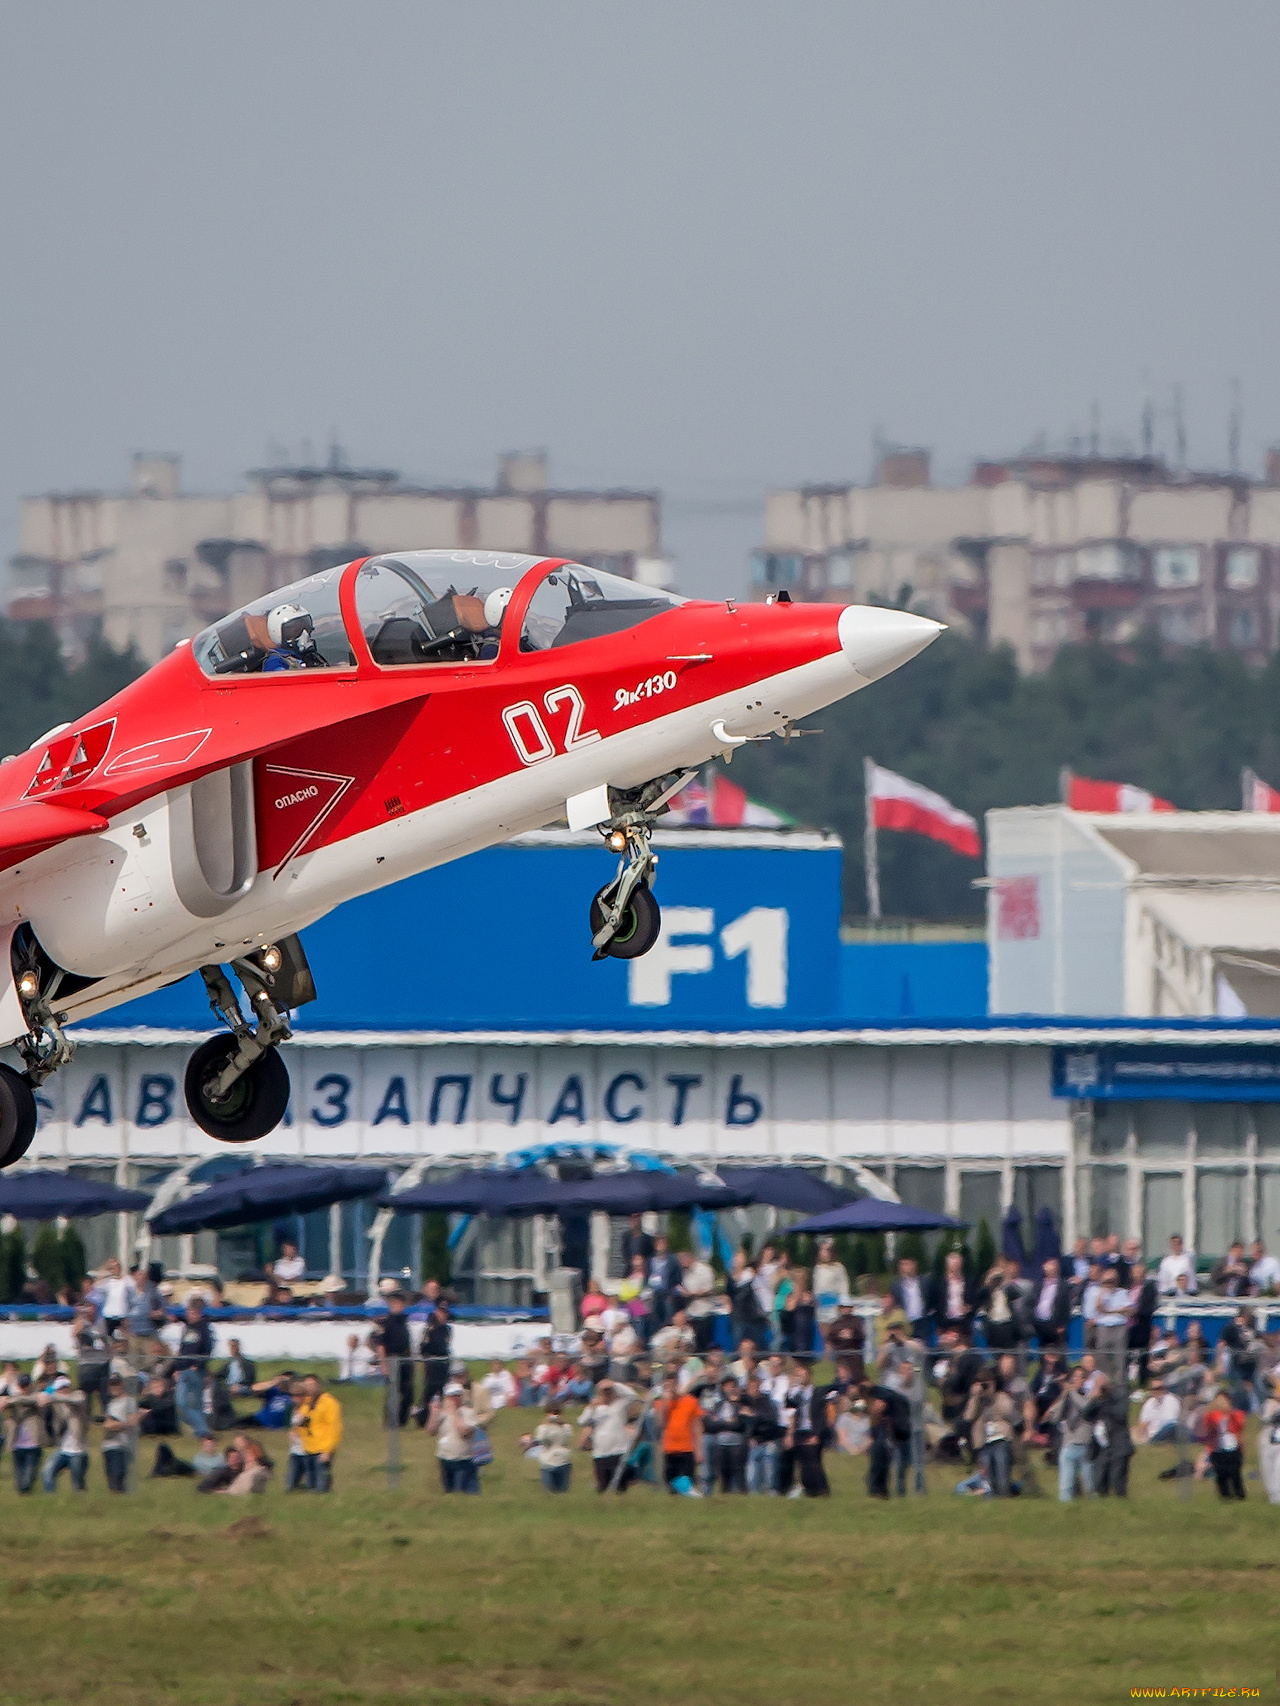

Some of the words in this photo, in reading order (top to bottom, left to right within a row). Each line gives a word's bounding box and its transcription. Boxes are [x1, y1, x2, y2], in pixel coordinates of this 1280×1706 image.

[501, 683, 602, 766] 02
[274, 785, 319, 809] ОПАСНО
[627, 906, 789, 1009] F1
[75, 1072, 764, 1127] АВЗАПЧАСТЬ
